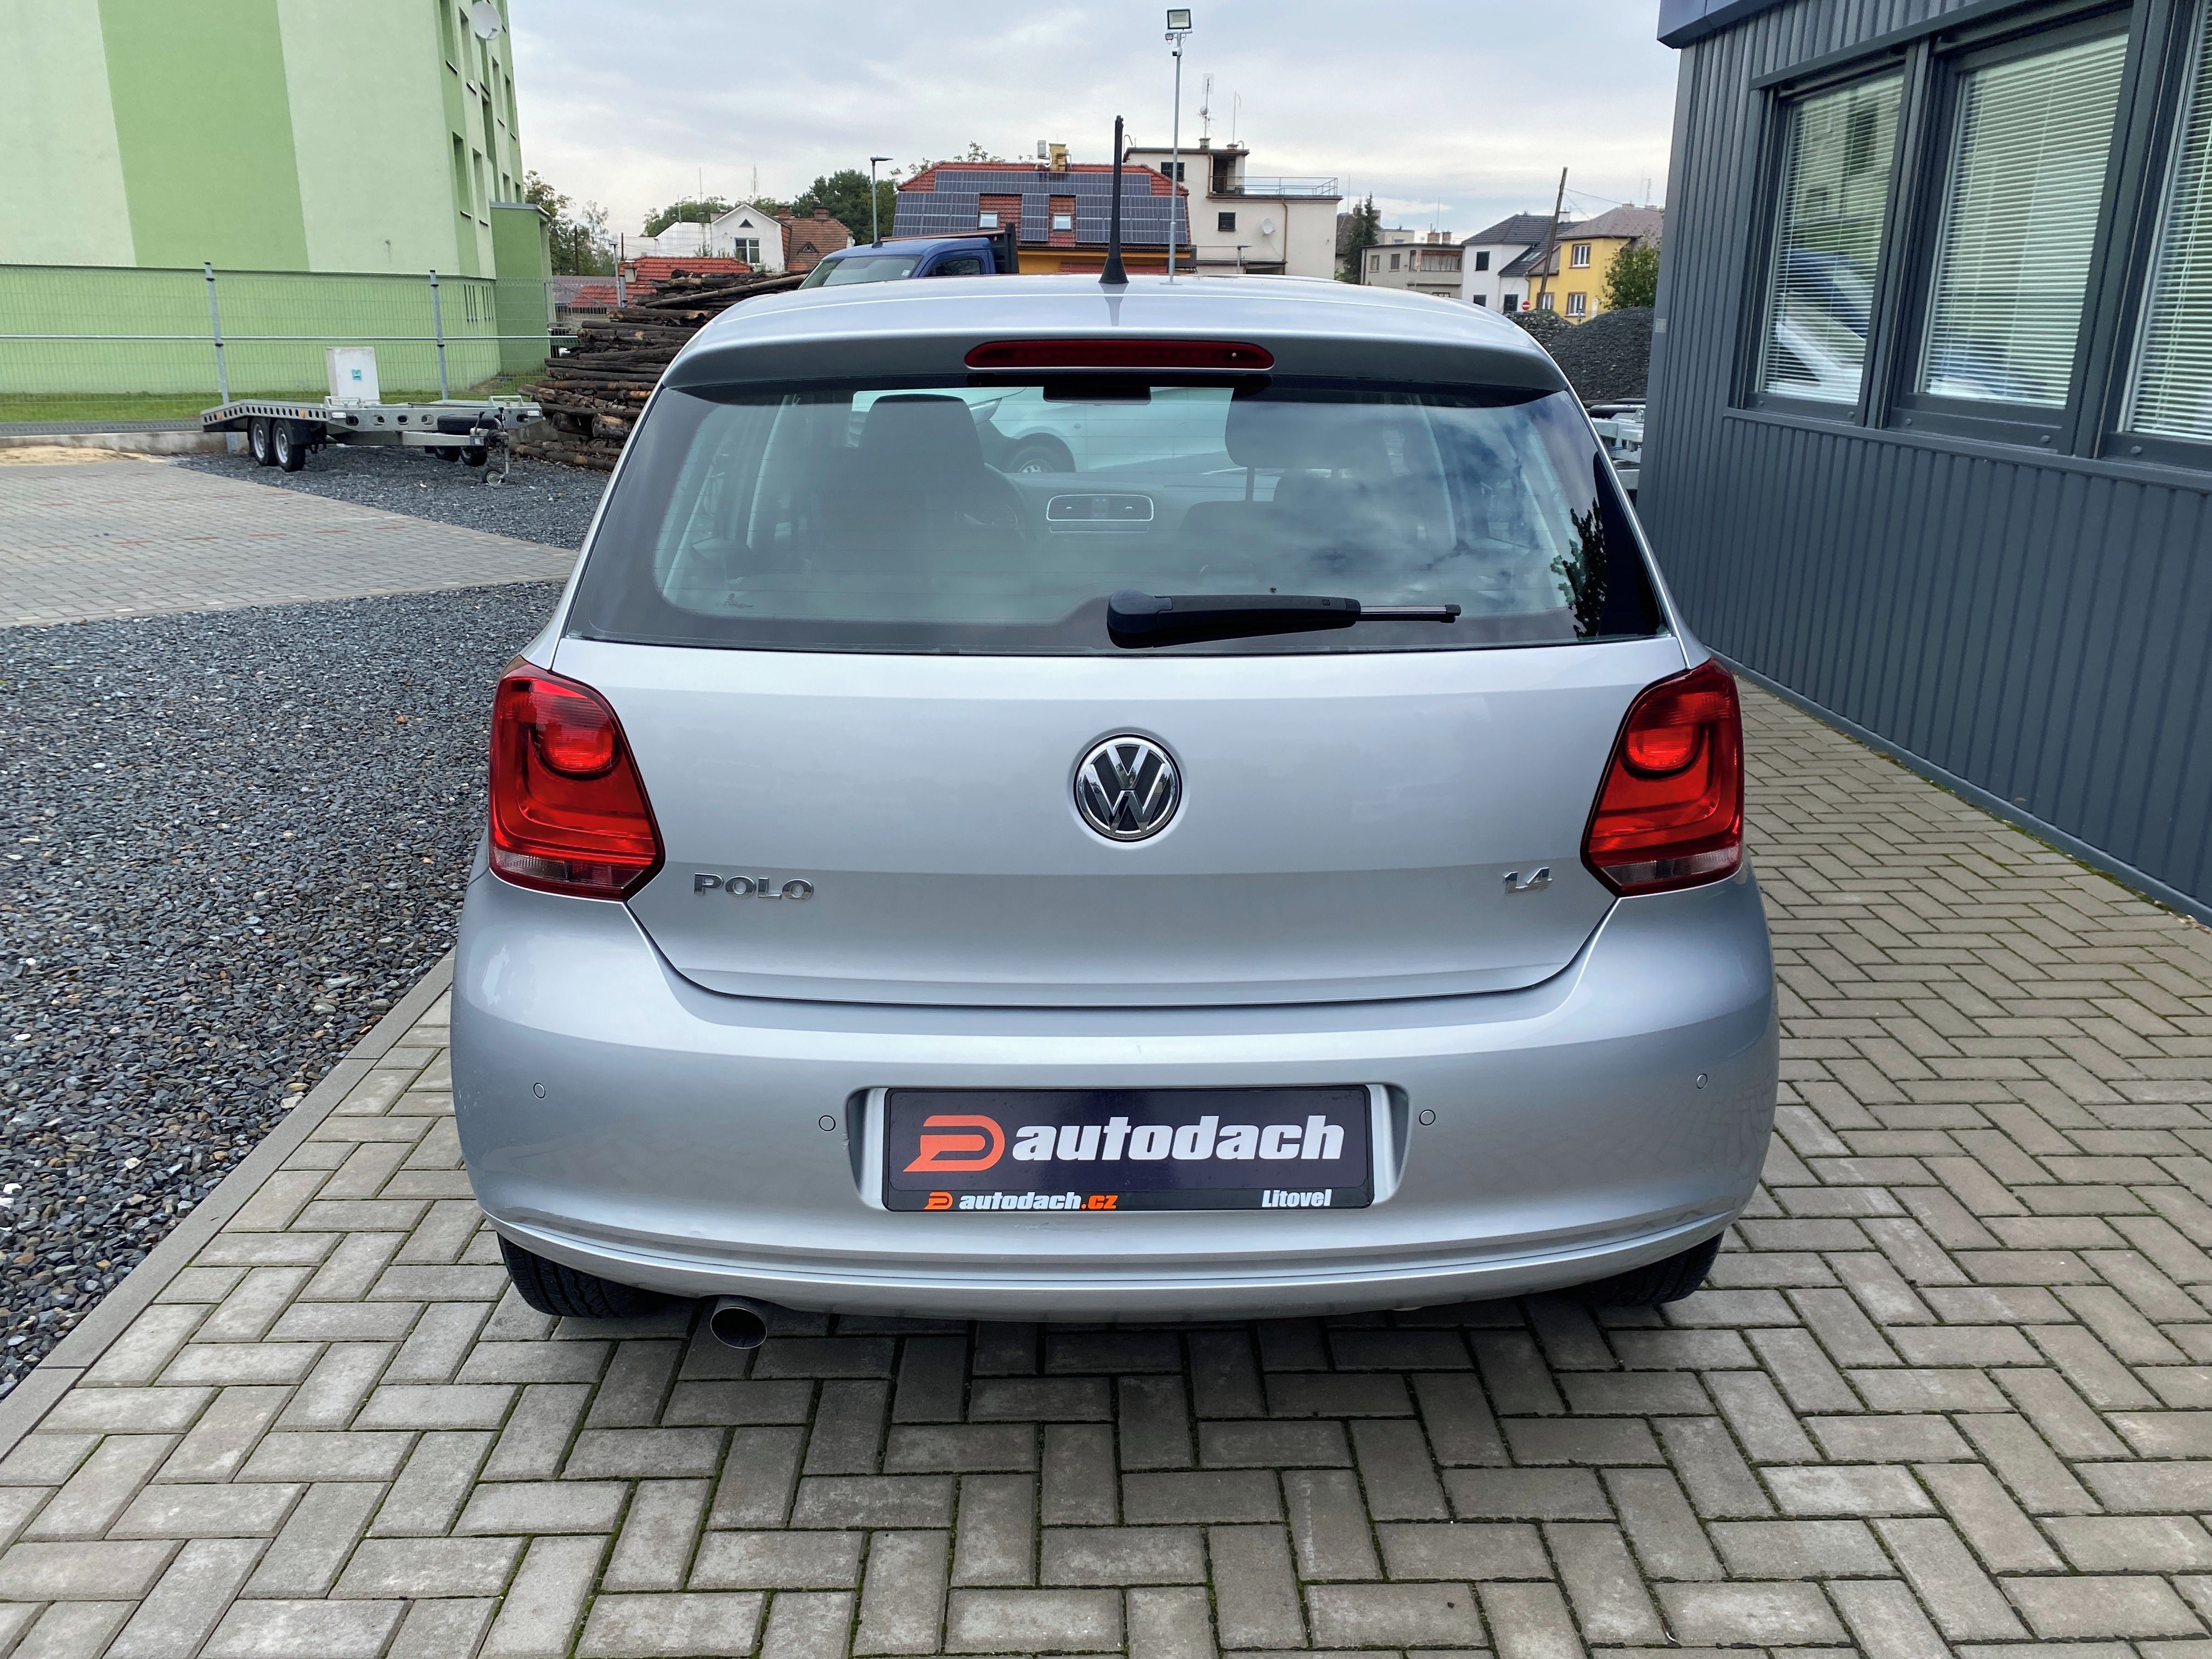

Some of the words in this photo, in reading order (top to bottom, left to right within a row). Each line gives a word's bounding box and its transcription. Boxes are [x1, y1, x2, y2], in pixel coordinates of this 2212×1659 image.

[693, 872, 814, 901] POLO
[1012, 1115, 1345, 1161] autodach
[958, 1192, 1119, 1210] autodach.cz
[1261, 1188, 1332, 1207] Litovel
